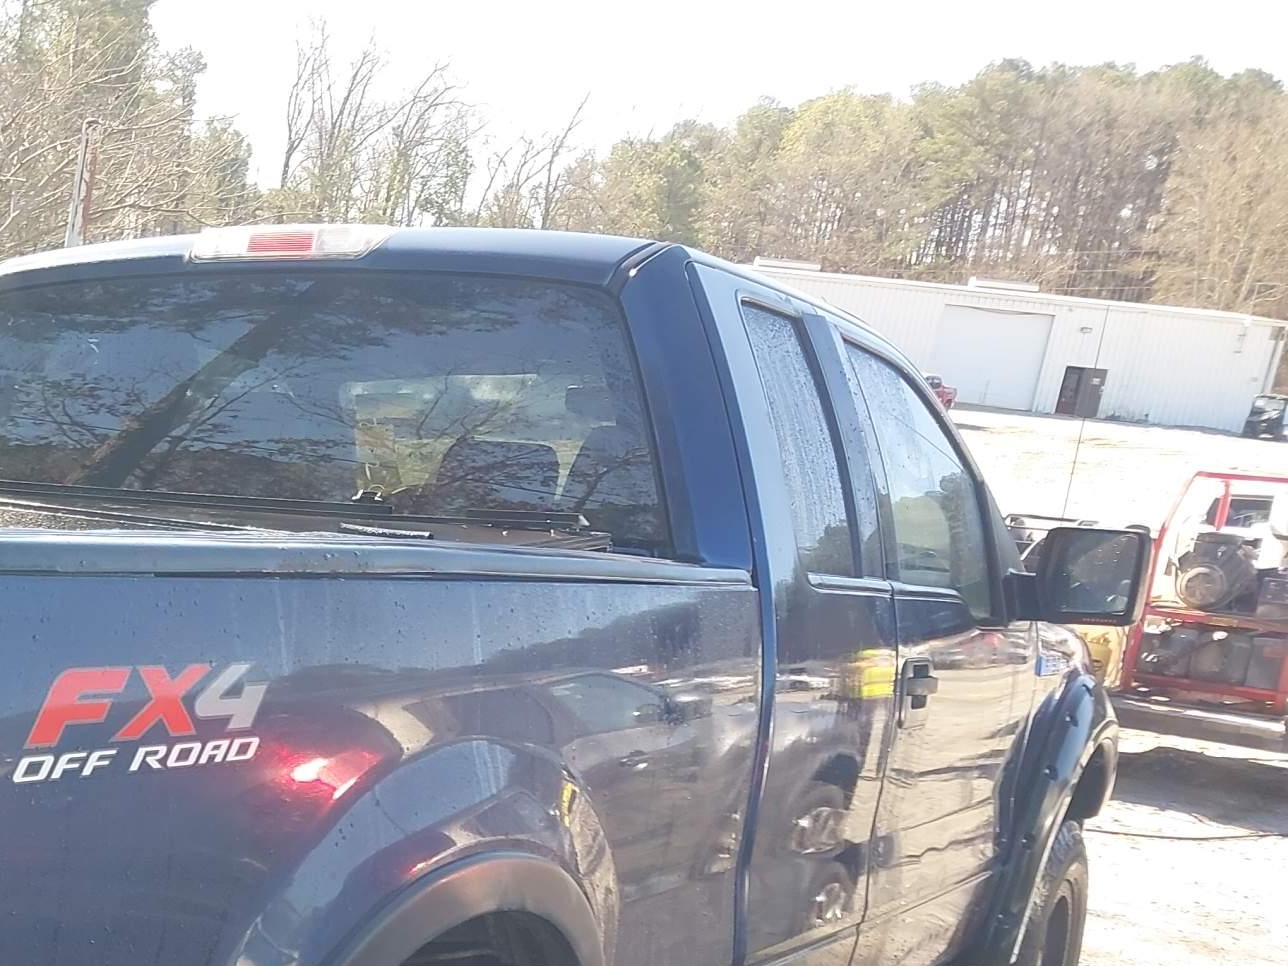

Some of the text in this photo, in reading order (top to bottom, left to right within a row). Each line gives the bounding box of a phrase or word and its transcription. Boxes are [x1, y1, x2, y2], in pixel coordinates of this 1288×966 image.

[23, 661, 269, 749] FX4
[12, 737, 261, 783] OFF ROAD
